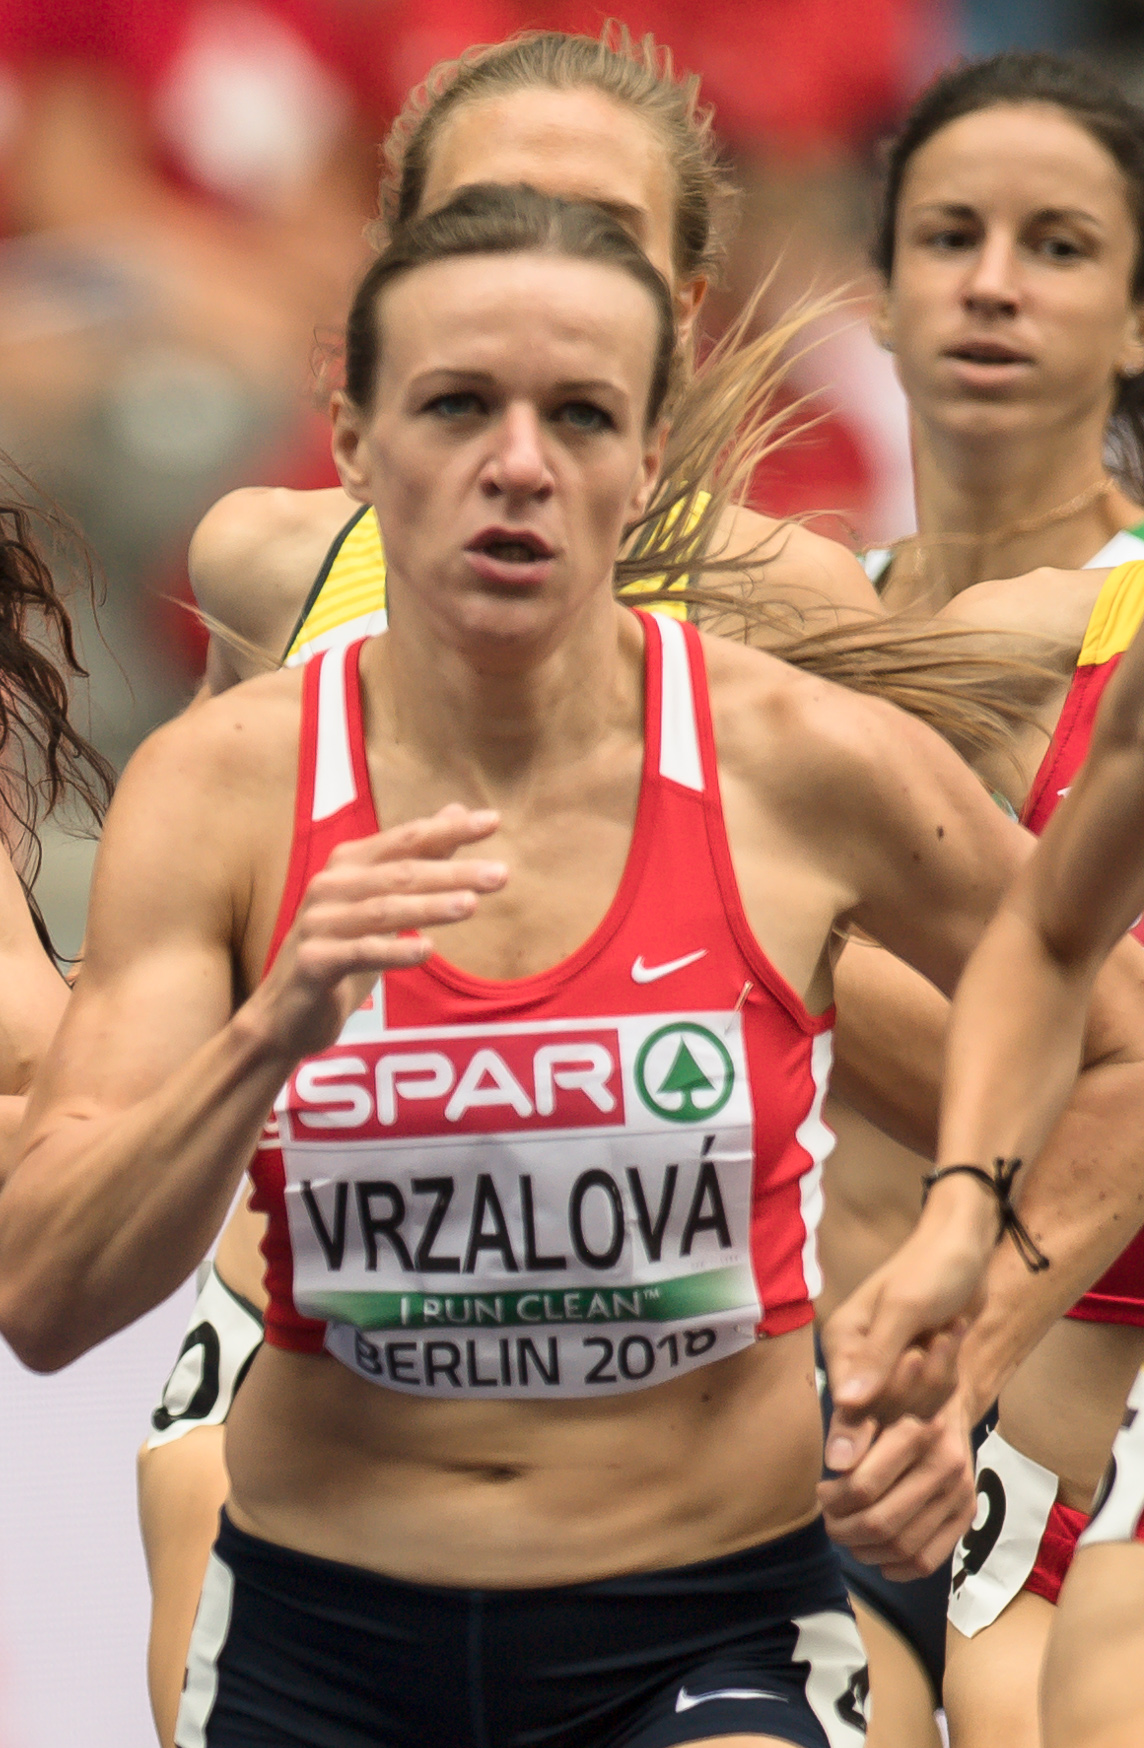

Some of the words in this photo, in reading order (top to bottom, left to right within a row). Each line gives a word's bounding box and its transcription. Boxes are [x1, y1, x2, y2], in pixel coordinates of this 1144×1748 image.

[295, 1042, 615, 1128] SPAR
[301, 1135, 732, 1273] VRZALOVÁ
[400, 1298, 408, 1325] I
[422, 1297, 502, 1324] RUN
[356, 1332, 560, 1388] BERLIN
